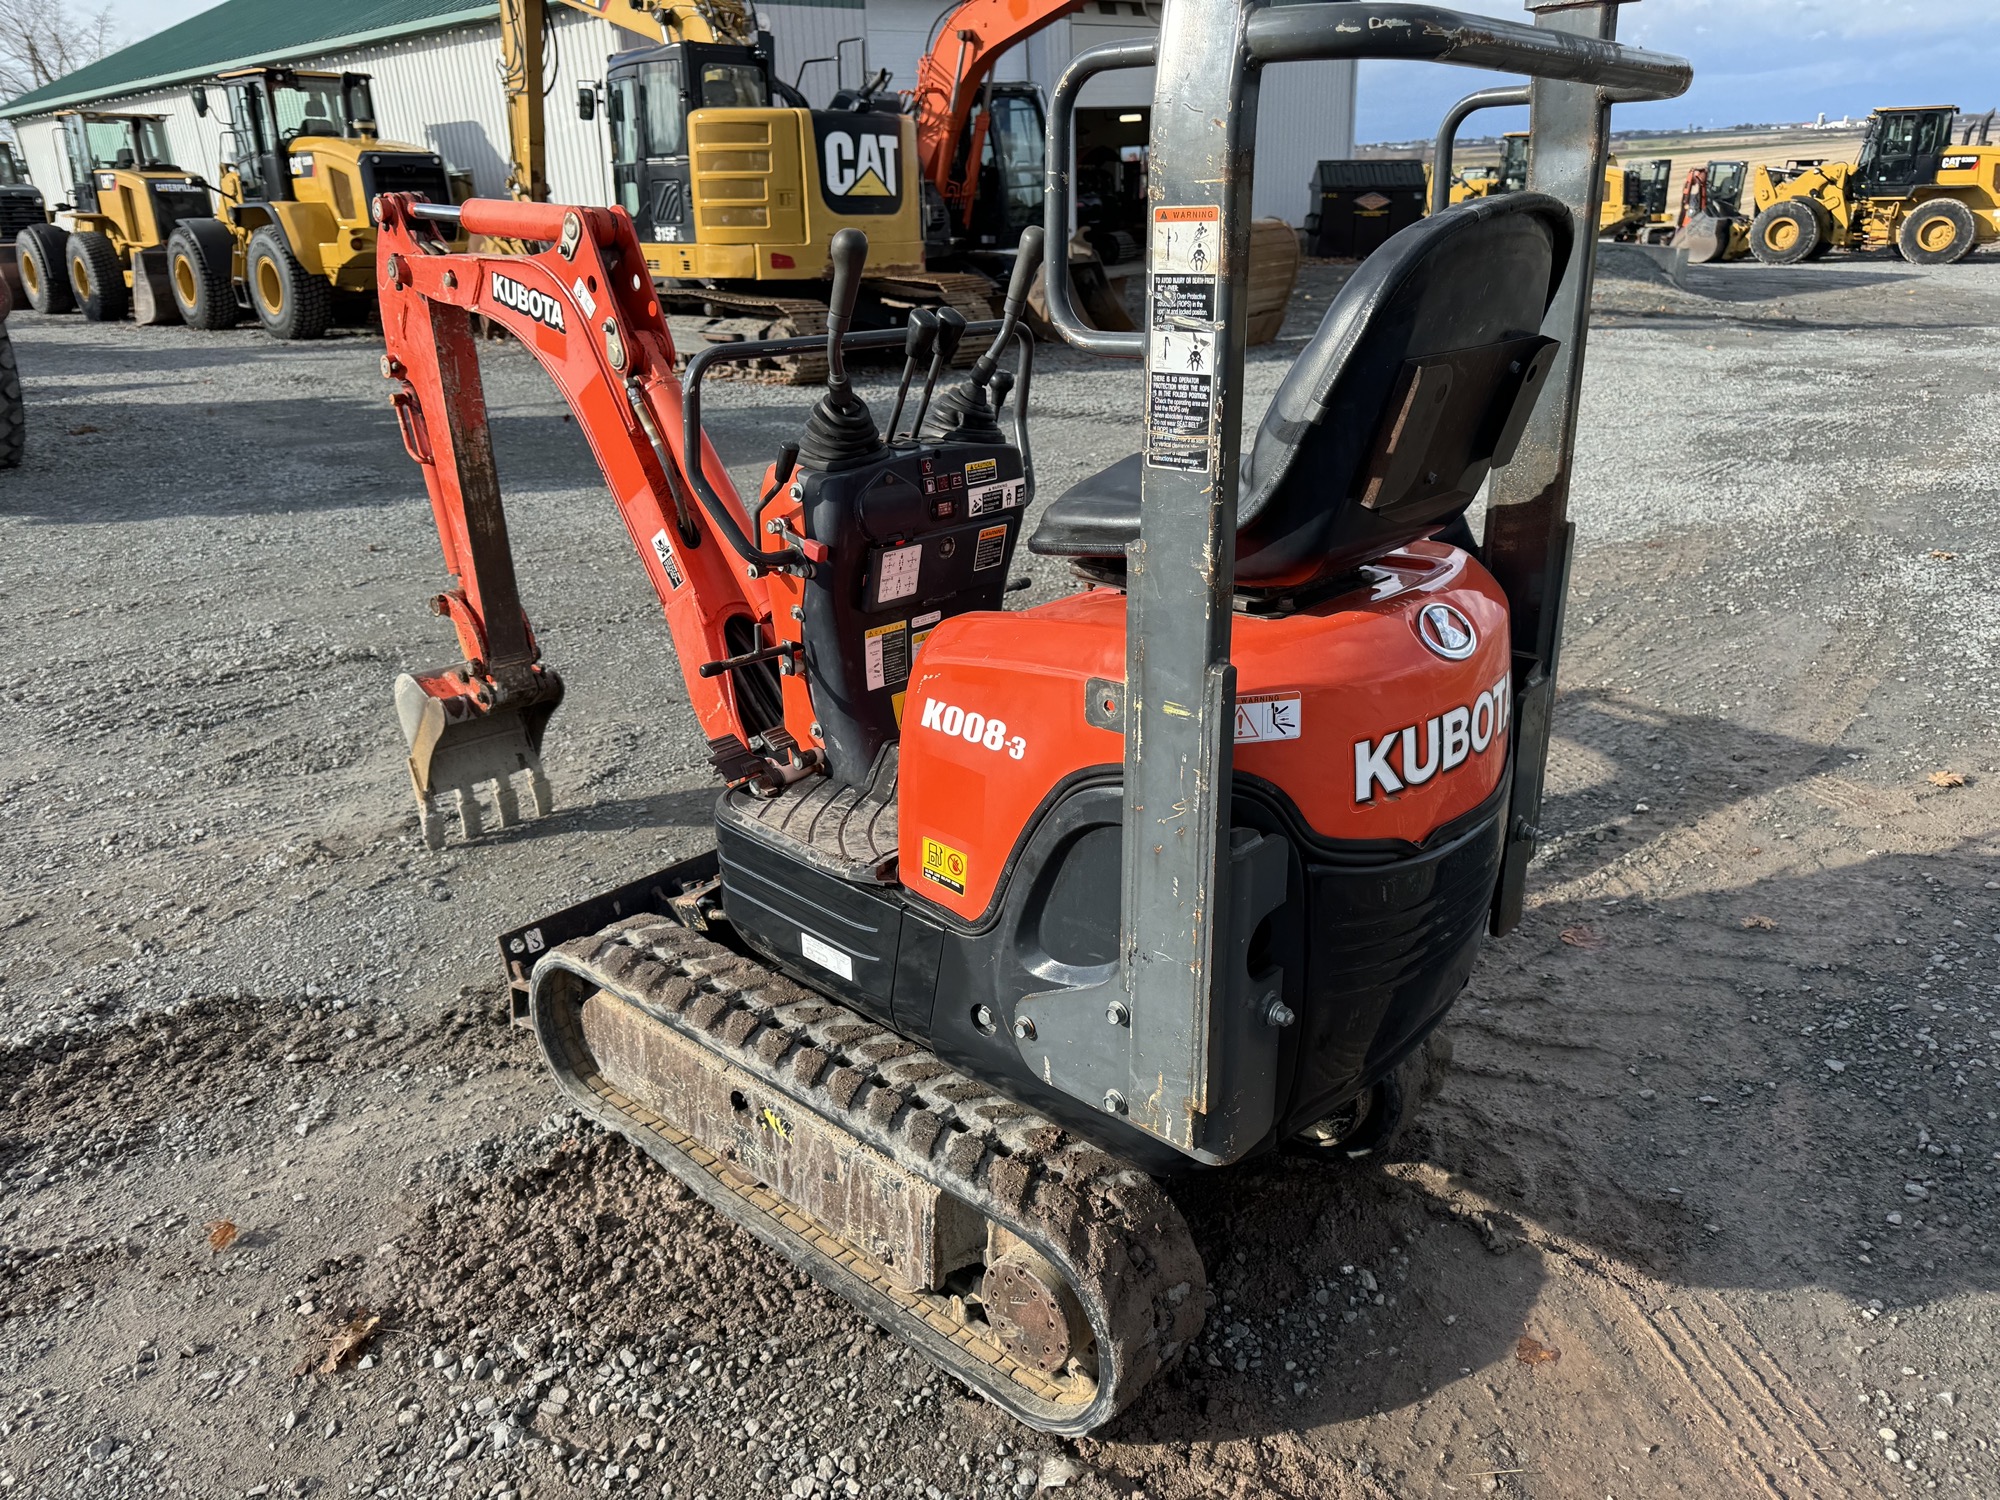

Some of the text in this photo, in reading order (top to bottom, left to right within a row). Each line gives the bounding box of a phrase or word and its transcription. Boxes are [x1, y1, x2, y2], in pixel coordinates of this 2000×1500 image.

[824, 131, 899, 196] CAT
[1941, 156, 1961, 169] CAT
[1173, 210, 1213, 219] WARNING
[654, 226, 677, 242] 315F
[492, 271, 566, 333] KUBOTA
[875, 624, 903, 635] CAUTION
[1240, 694, 1280, 703] WARNING
[921, 697, 1027, 760] K008-3
